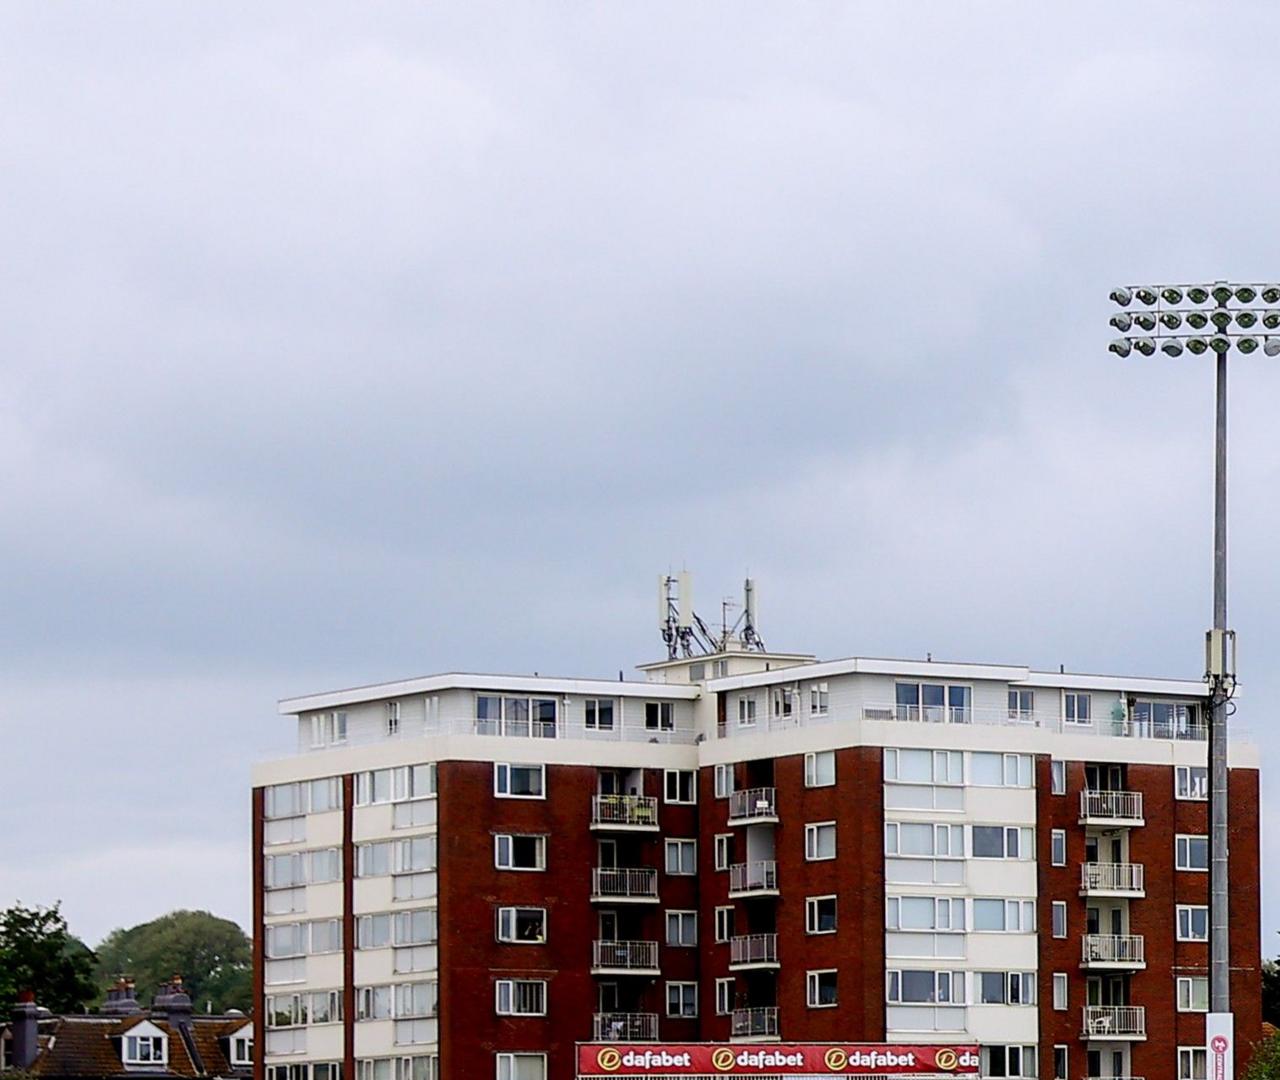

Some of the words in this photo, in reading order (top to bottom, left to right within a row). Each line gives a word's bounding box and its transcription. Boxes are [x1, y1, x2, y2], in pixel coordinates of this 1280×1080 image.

[622, 1052, 690, 1068] dafabet
[737, 1052, 803, 1068] dafabet
[849, 1051, 914, 1068] dafabet
